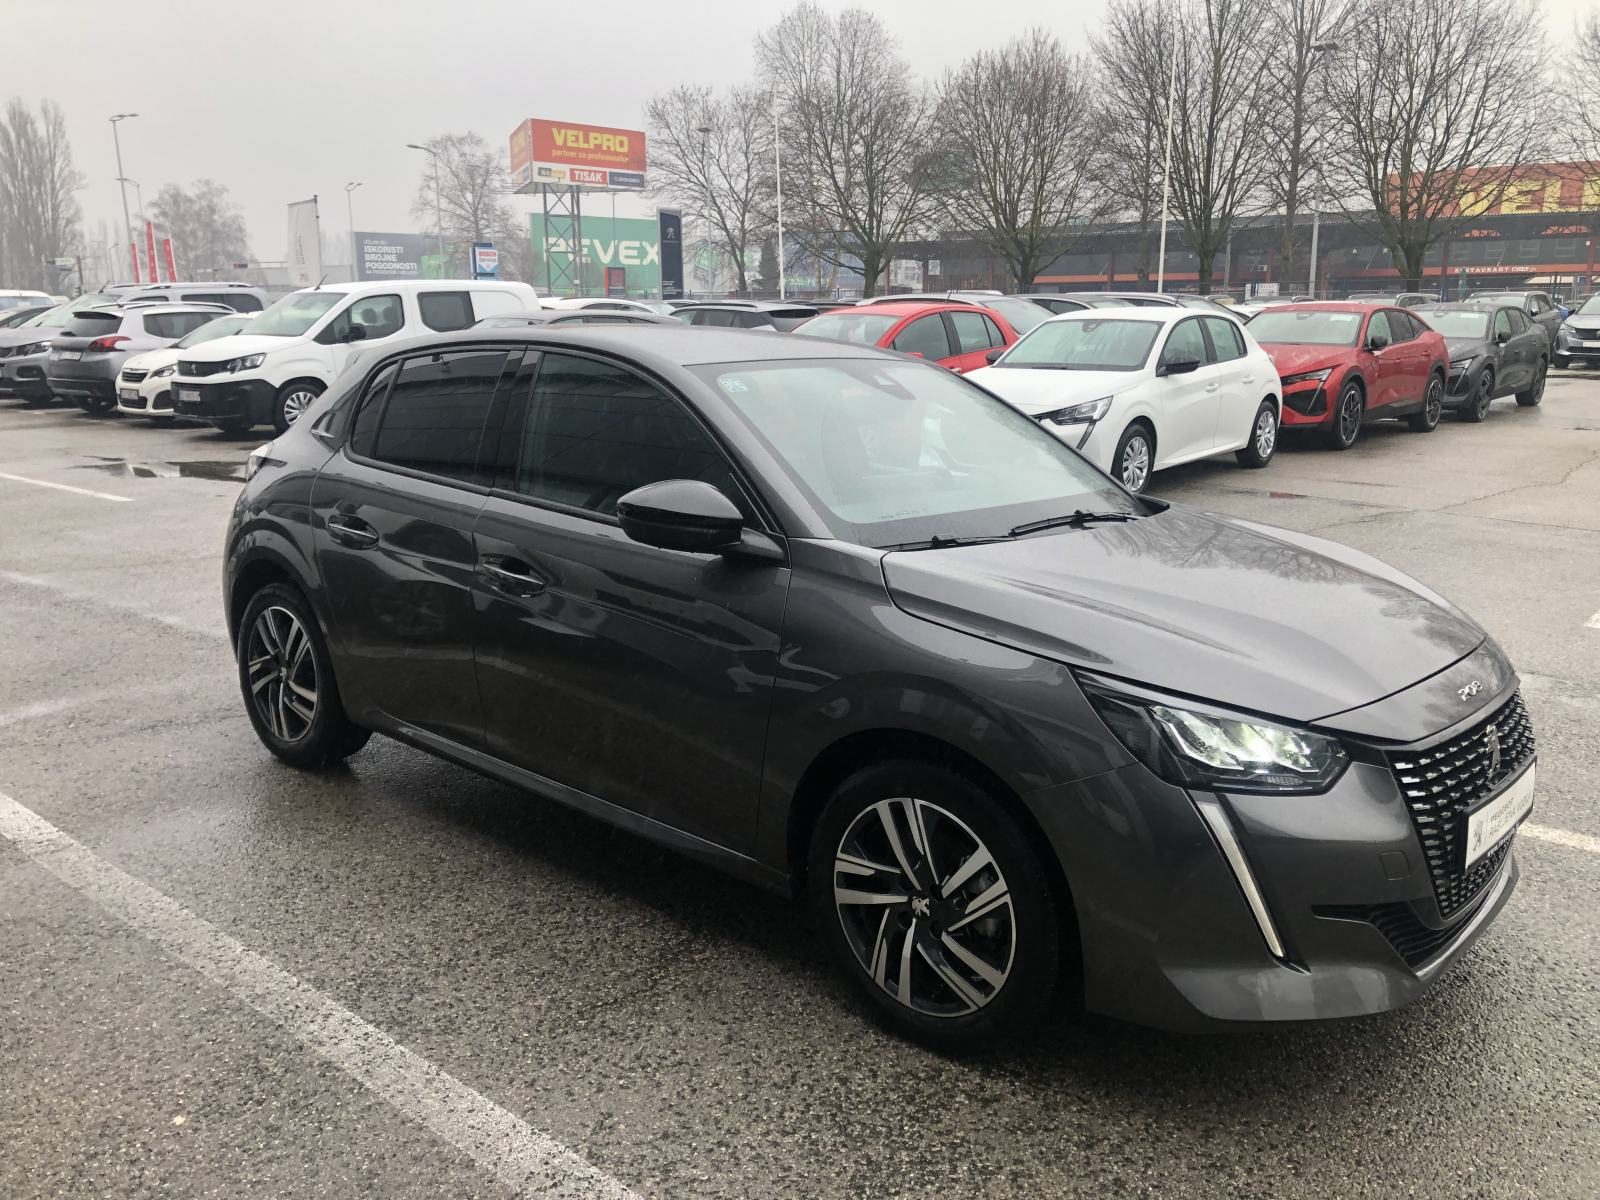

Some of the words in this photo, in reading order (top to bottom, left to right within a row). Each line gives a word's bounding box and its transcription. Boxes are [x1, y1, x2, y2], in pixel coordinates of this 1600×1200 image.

[552, 128, 628, 153] VELPRO
[552, 149, 577, 157] partner
[574, 171, 603, 182] TISAK
[364, 245, 403, 254] ISKORISTI
[365, 262, 417, 270] POGODNOSTI
[1458, 680, 1483, 701] 208
